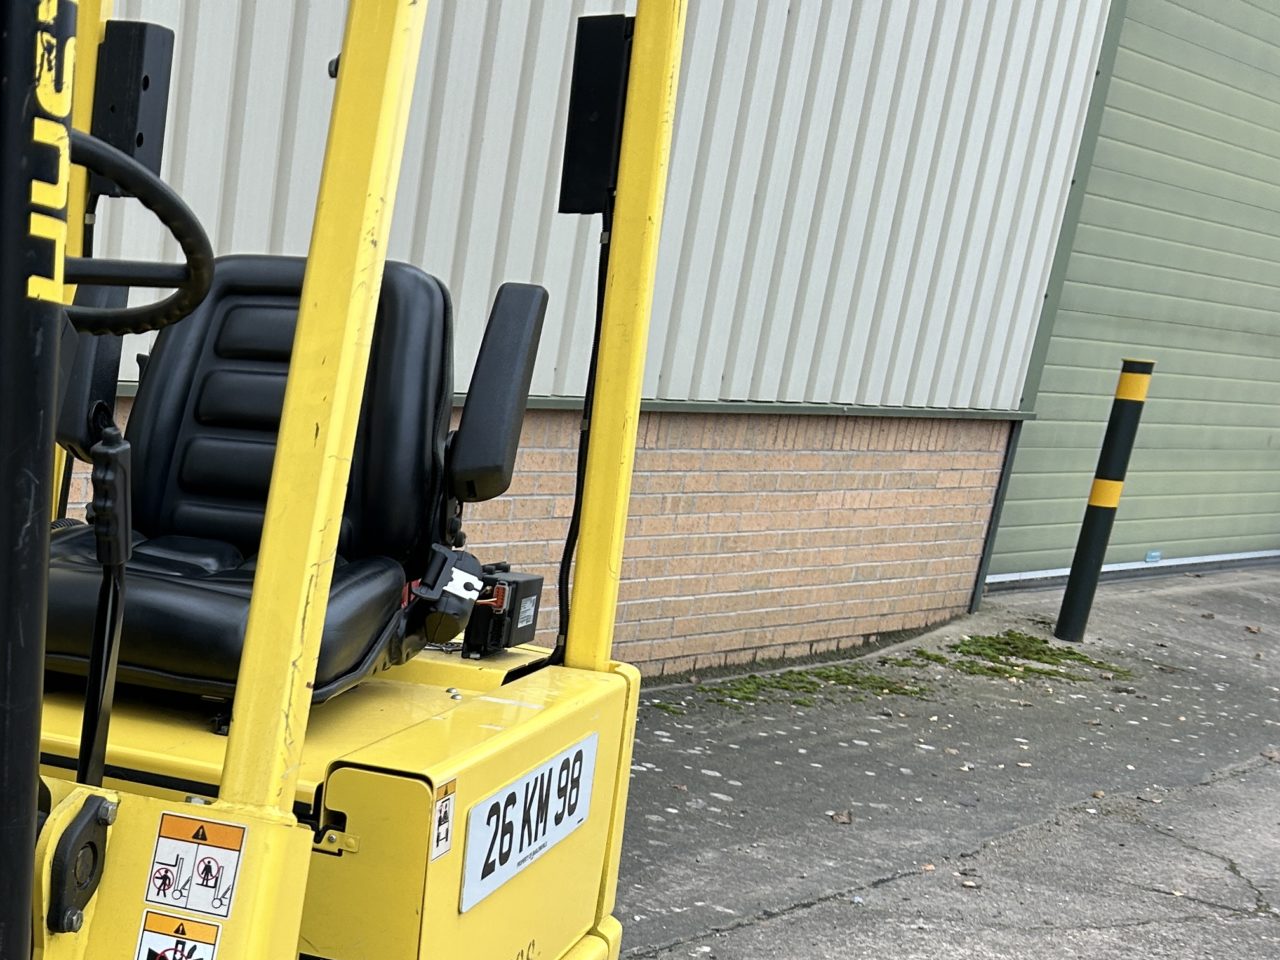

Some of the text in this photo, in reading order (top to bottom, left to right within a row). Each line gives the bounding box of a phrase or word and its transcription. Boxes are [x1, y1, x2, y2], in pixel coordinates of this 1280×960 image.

[27, 0, 77, 304] HYS
[481, 749, 583, 880] 26 KM 98
